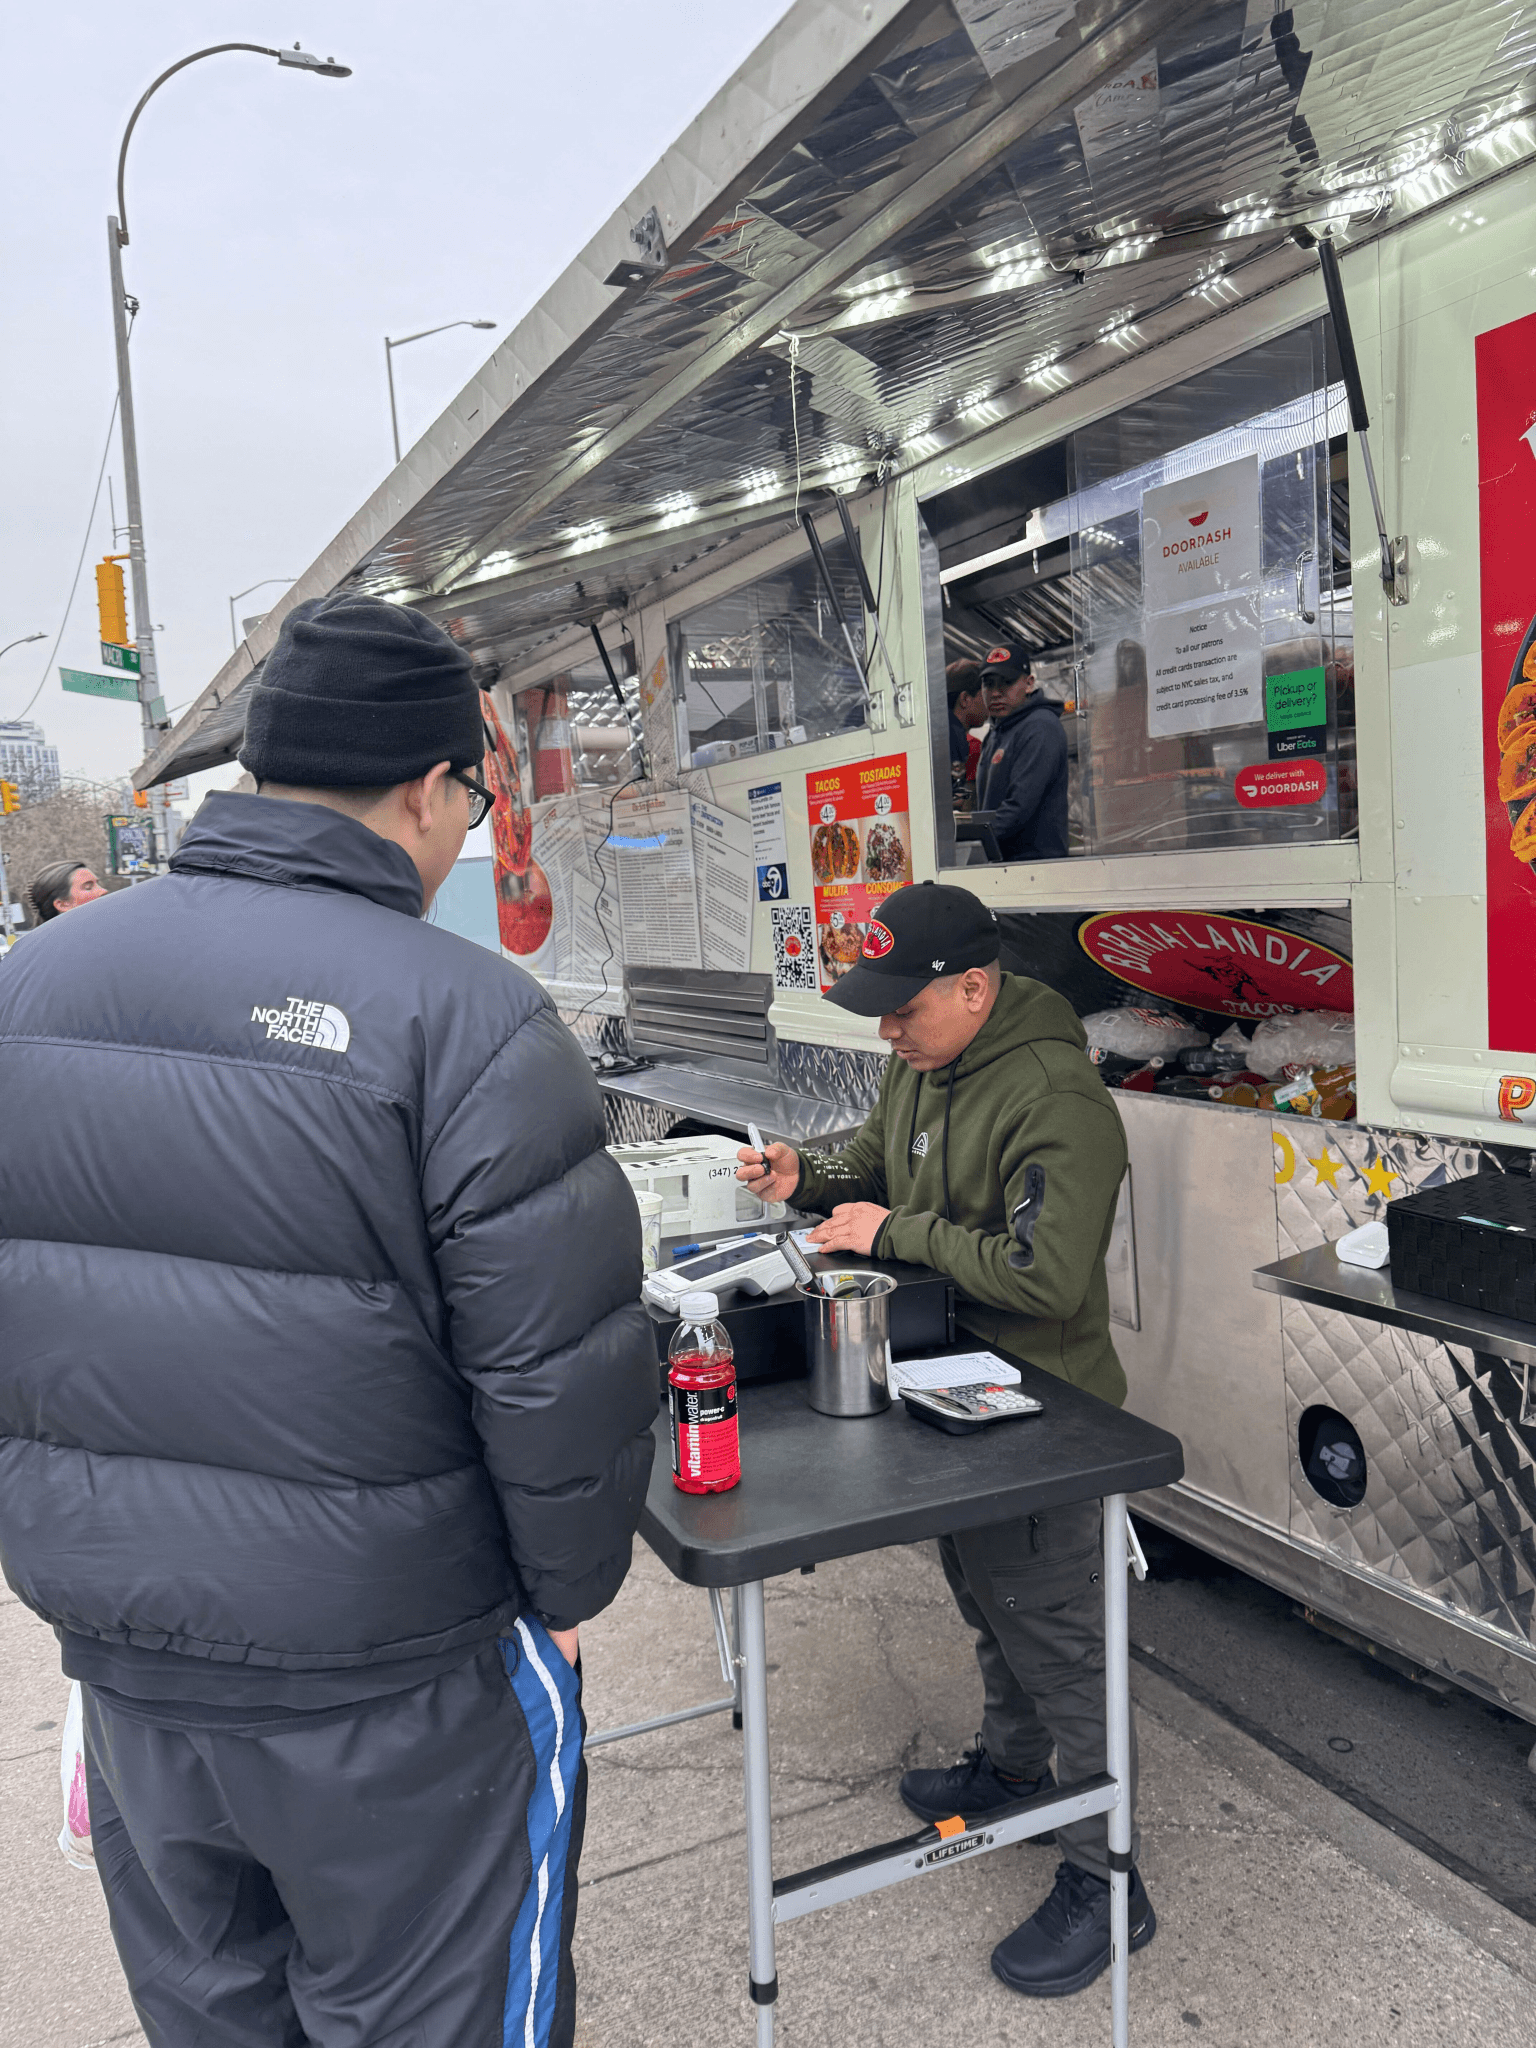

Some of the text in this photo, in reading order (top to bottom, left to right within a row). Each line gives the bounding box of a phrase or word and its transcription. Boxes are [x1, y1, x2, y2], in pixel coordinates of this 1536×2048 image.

[1163, 527, 1231, 558] DOORDASH
[1178, 552, 1219, 574] AVAILABLE
[1189, 623, 1207, 634] Notice
[1175, 646, 1181, 655] To
[1190, 643, 1201, 652] our
[1201, 638, 1223, 650] patrons
[1162, 665, 1177, 676] credit
[1178, 662, 1192, 672] cards
[1193, 656, 1226, 668] transaction
[1156, 684, 1174, 695] subject
[1174, 682, 1181, 690] to
[1181, 680, 1193, 689] NYC
[1193, 677, 1208, 686] sales
[1221, 672, 1233, 682] and
[1273, 681, 1317, 697] Pickup or
[1156, 687, 1249, 712] credit card processing fee of 3.5%
[1274, 693, 1317, 710] delivery?
[1276, 739, 1316, 752] Uber Eats
[859, 764, 901, 784] TOSTADAS
[1254, 768, 1305, 782] We deliver with
[815, 777, 840, 793] TACOS
[1260, 780, 1319, 795] DOORDASH
[823, 885, 849, 897] MULITA
[1097, 922, 1342, 986] BIRRIA-LANDIA
[286, 997, 324, 1018] THE
[250, 1006, 319, 1032] NORTH
[266, 1024, 316, 1046] FACE
[708, 1167, 731, 1179] (347)
[700, 1406, 725, 1417] power-c
[932, 1837, 979, 1860] LIFETIME
